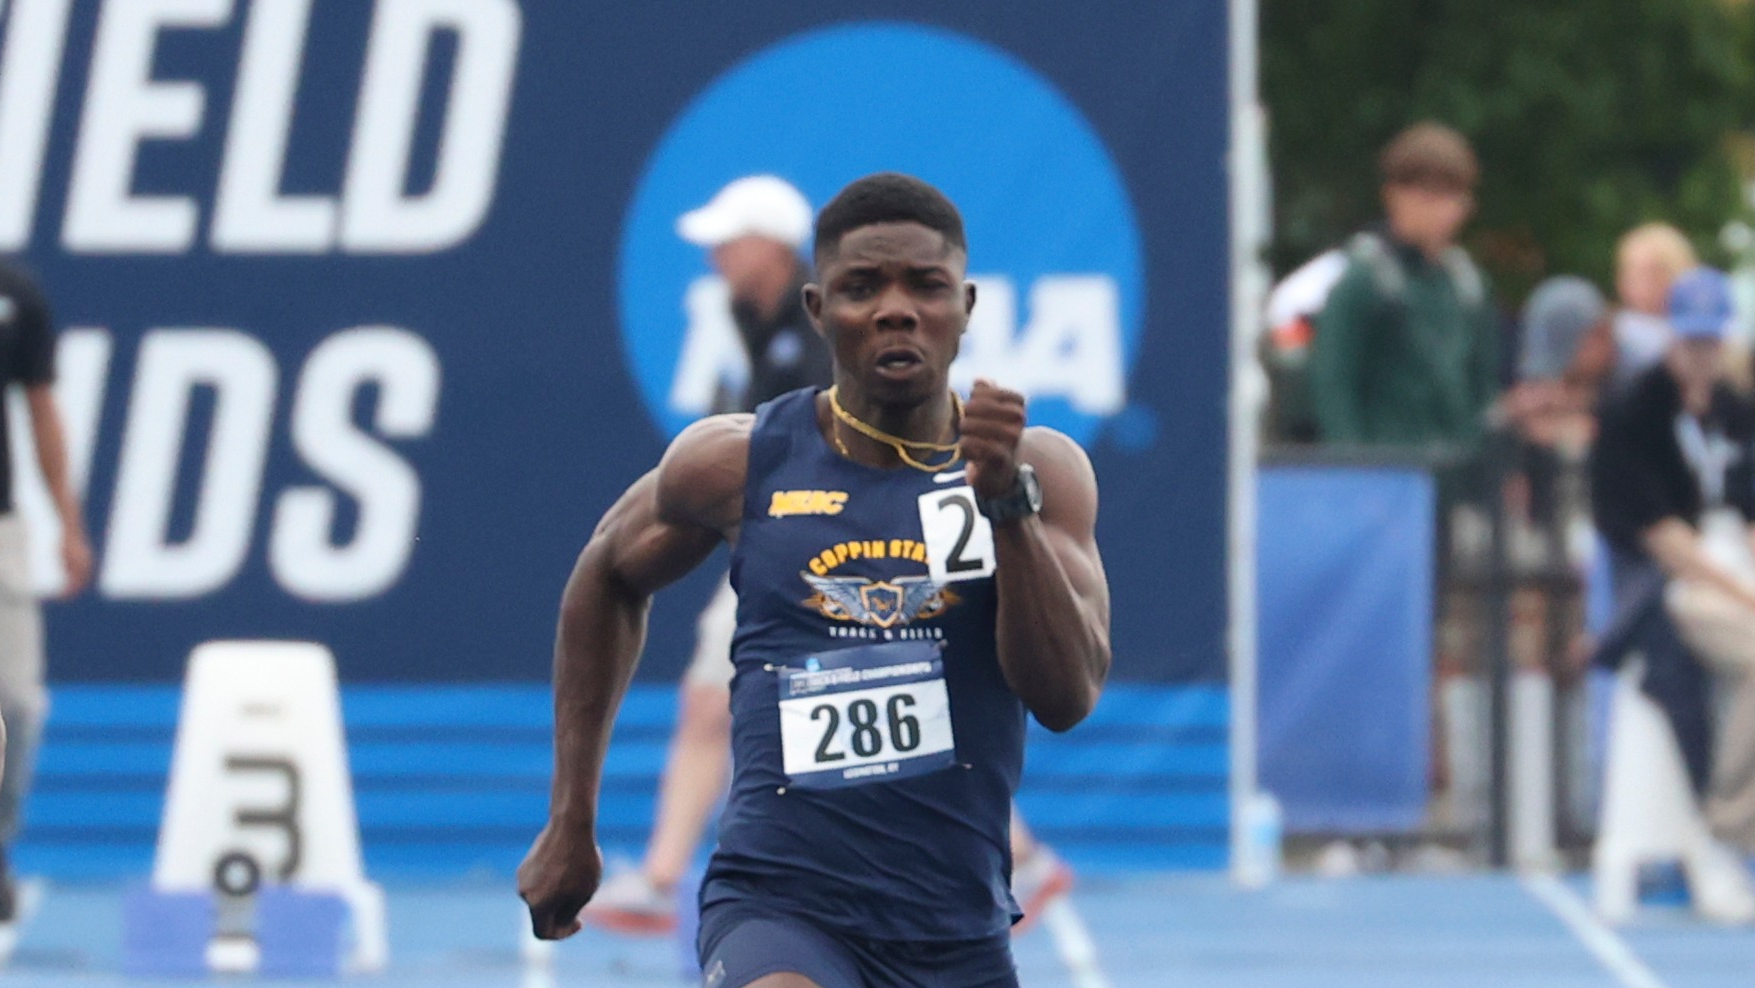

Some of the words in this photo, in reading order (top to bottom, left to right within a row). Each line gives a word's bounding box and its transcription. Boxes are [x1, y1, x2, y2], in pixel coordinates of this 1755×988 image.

[808, 540, 885, 576] COPPIN
[938, 494, 984, 573] 2
[810, 693, 921, 763] 286
[223, 755, 302, 882] 3
